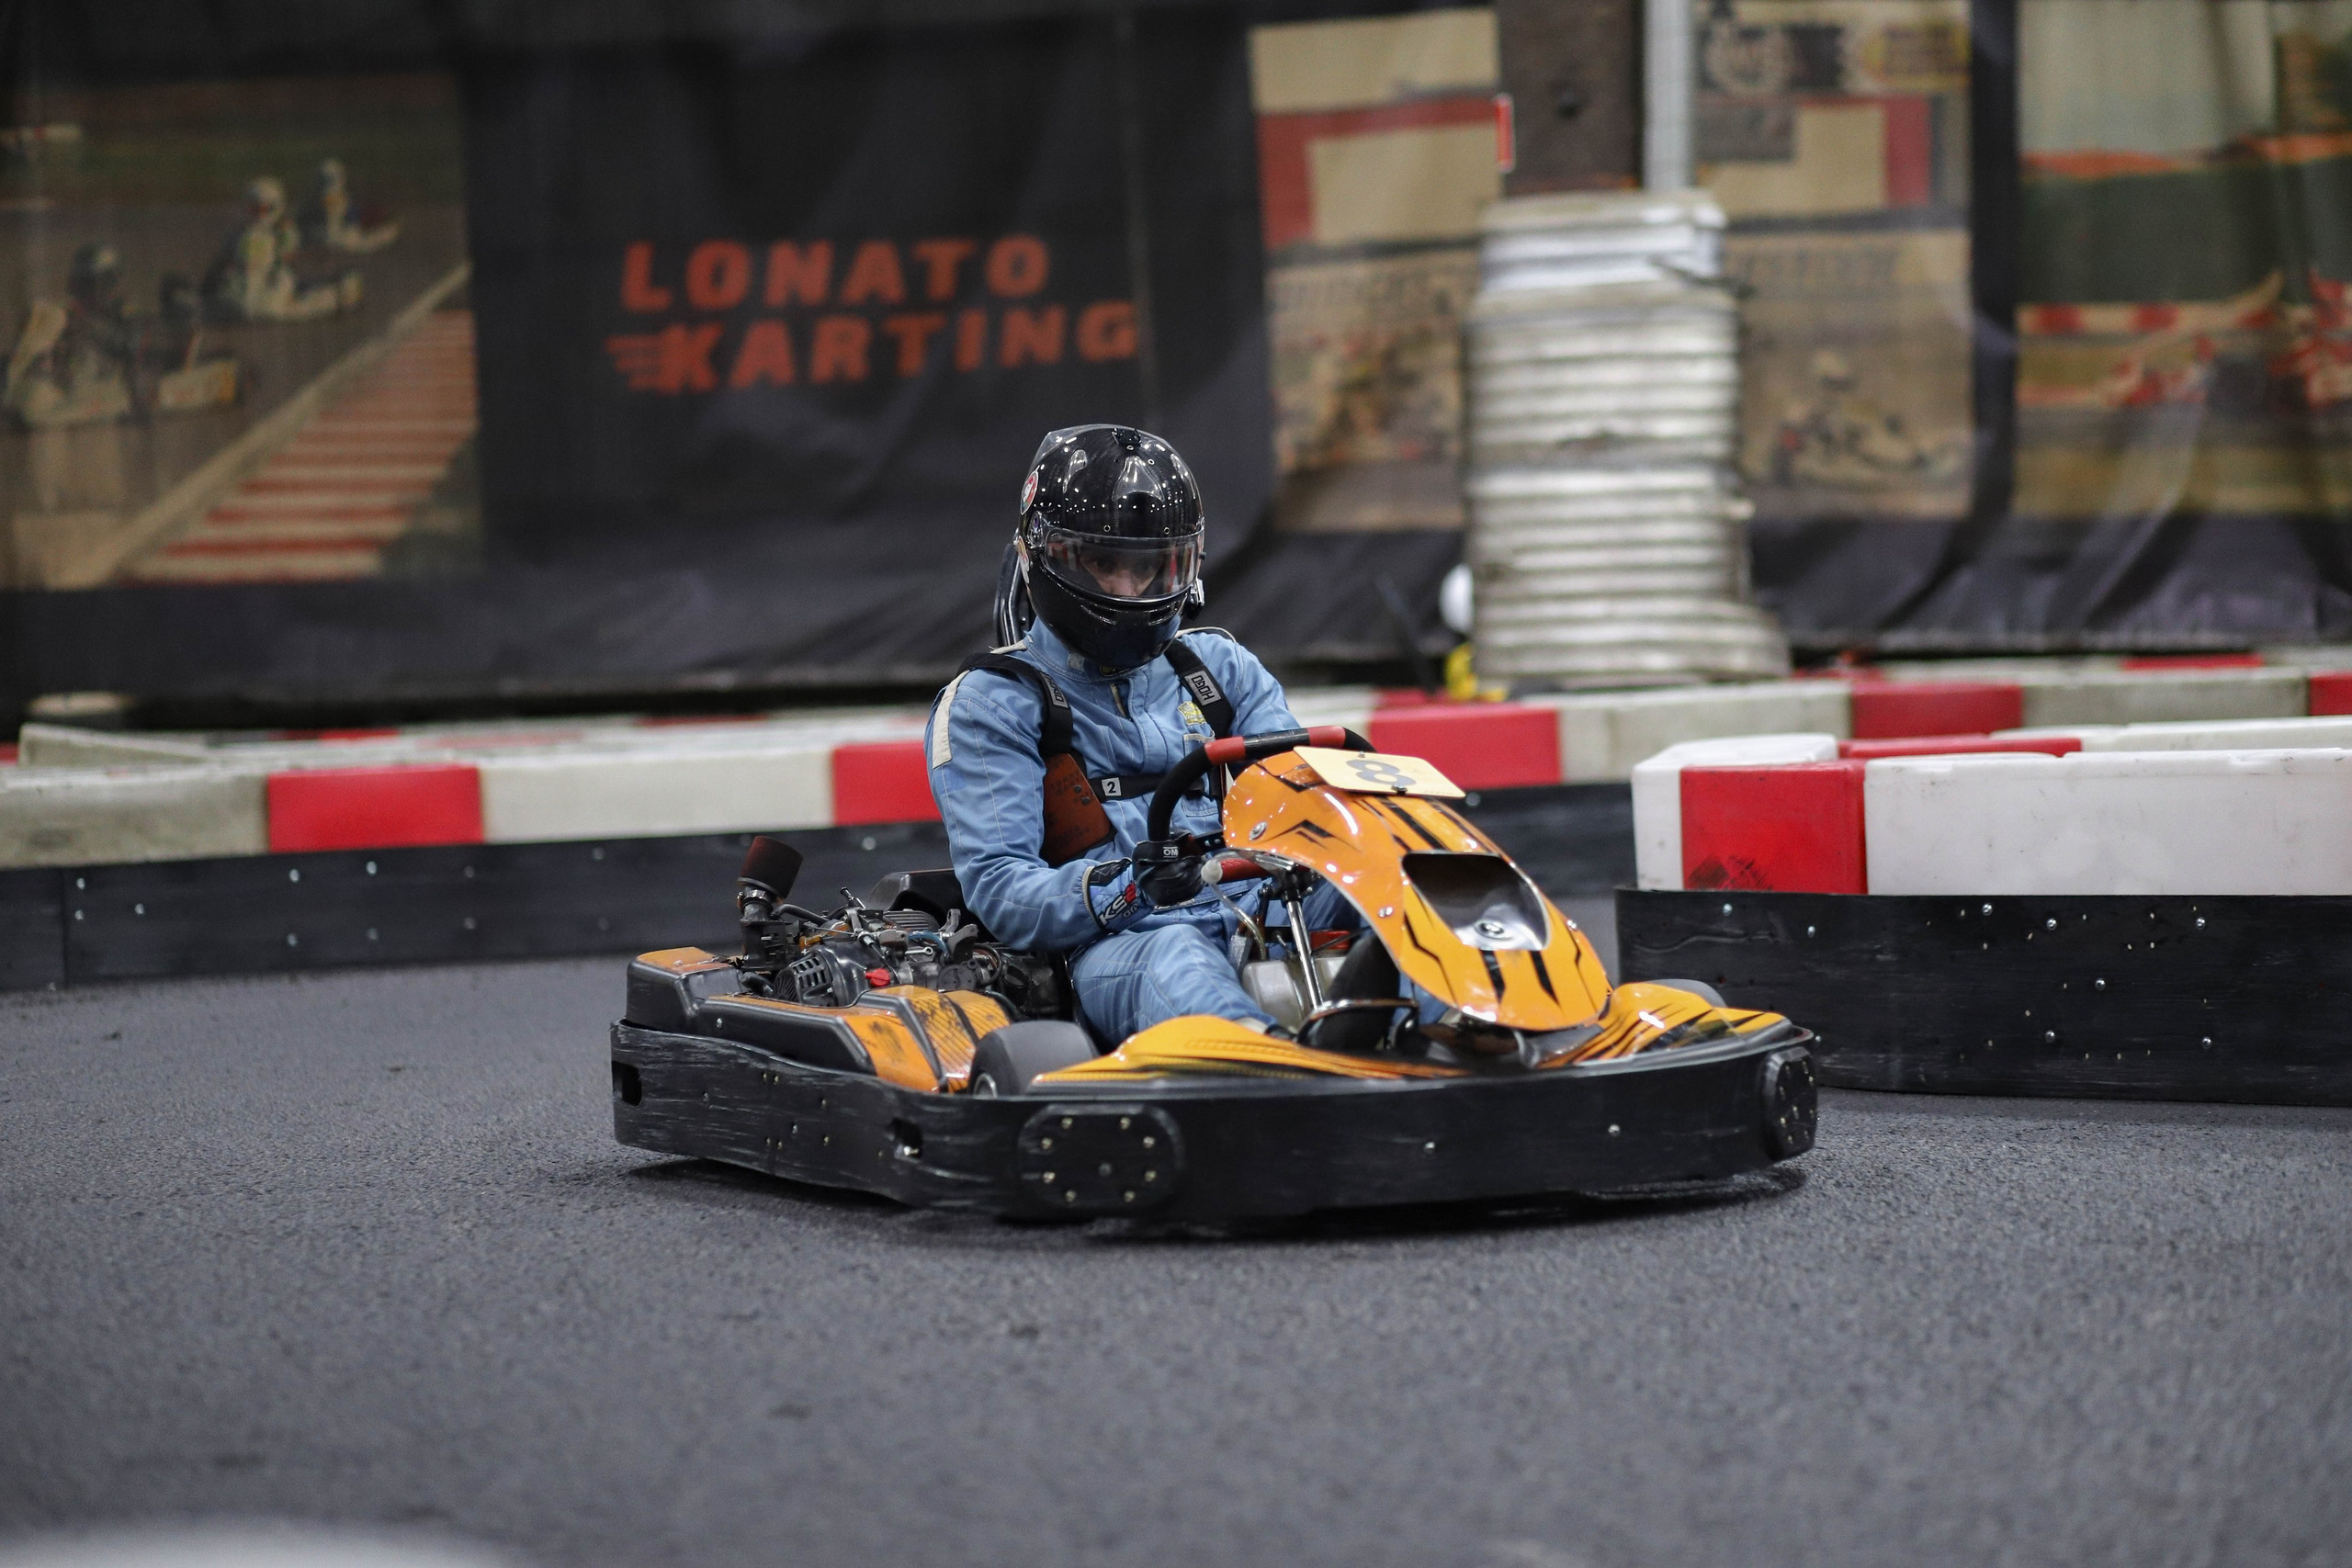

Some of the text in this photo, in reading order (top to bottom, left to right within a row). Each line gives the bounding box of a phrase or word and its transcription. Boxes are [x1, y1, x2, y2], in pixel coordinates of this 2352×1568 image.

[620, 233, 1049, 311] LONATO
[649, 299, 1138, 394] KARTING
[1106, 781, 1117, 794] 2
[1345, 759, 1417, 786] 8
